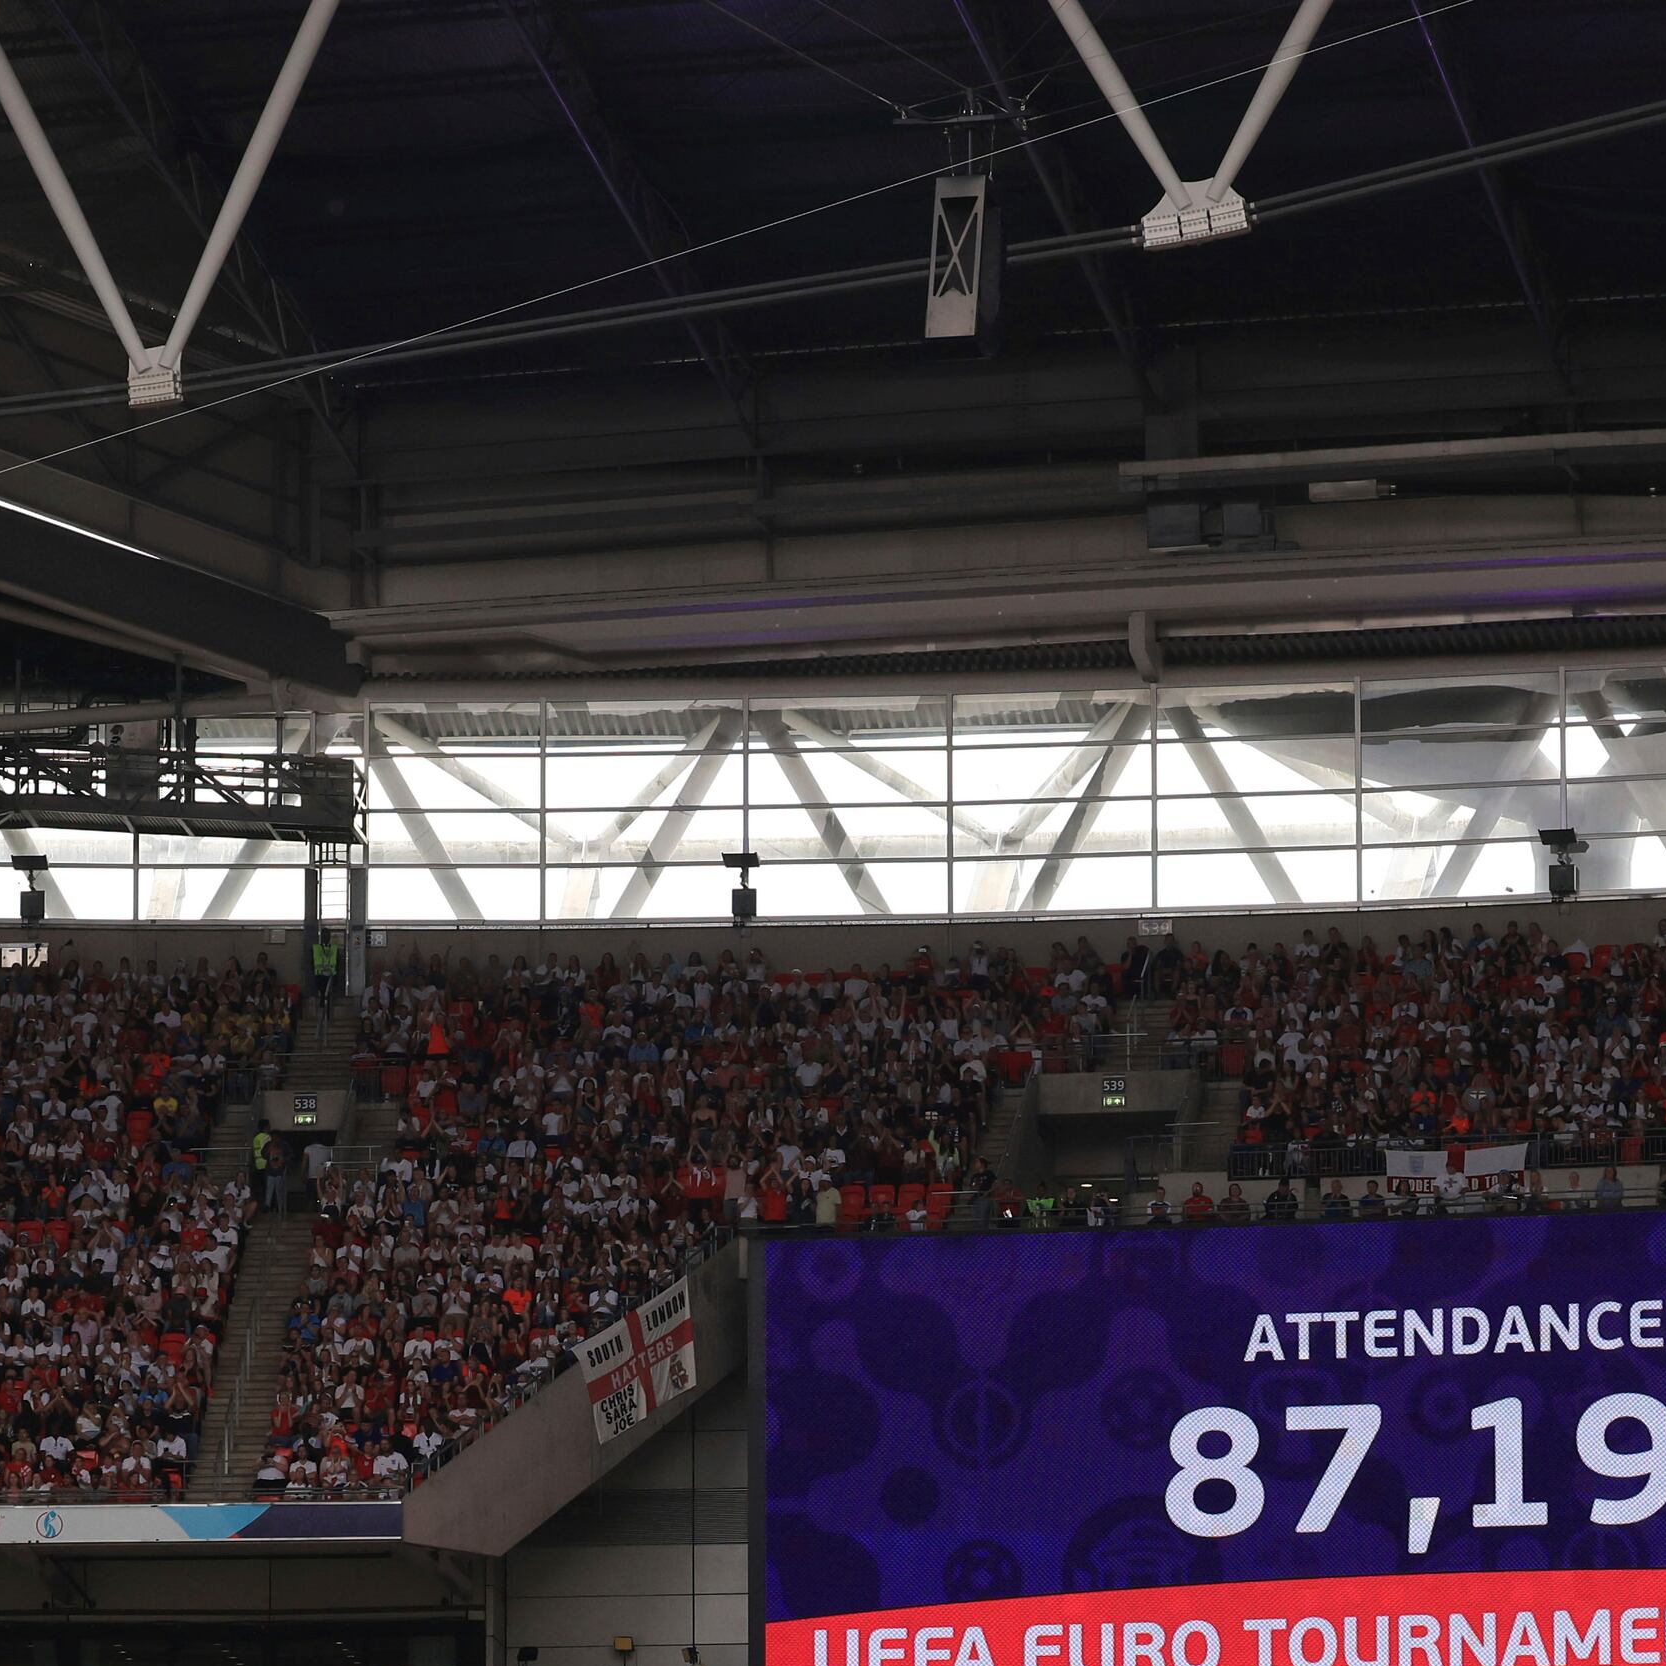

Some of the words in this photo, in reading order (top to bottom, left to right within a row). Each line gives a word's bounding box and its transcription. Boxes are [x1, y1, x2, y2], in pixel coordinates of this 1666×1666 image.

[1102, 1079, 1126, 1092] 539
[294, 1098, 316, 1109] 538
[587, 1335, 624, 1368] SOUTH
[645, 1288, 686, 1332] LONDON
[1244, 1299, 1665, 1363] ATTENDANCE
[610, 1335, 675, 1389] HATTERS
[600, 1383, 636, 1414] CHRIS
[604, 1397, 638, 1426] SARA
[612, 1411, 636, 1436] JOE
